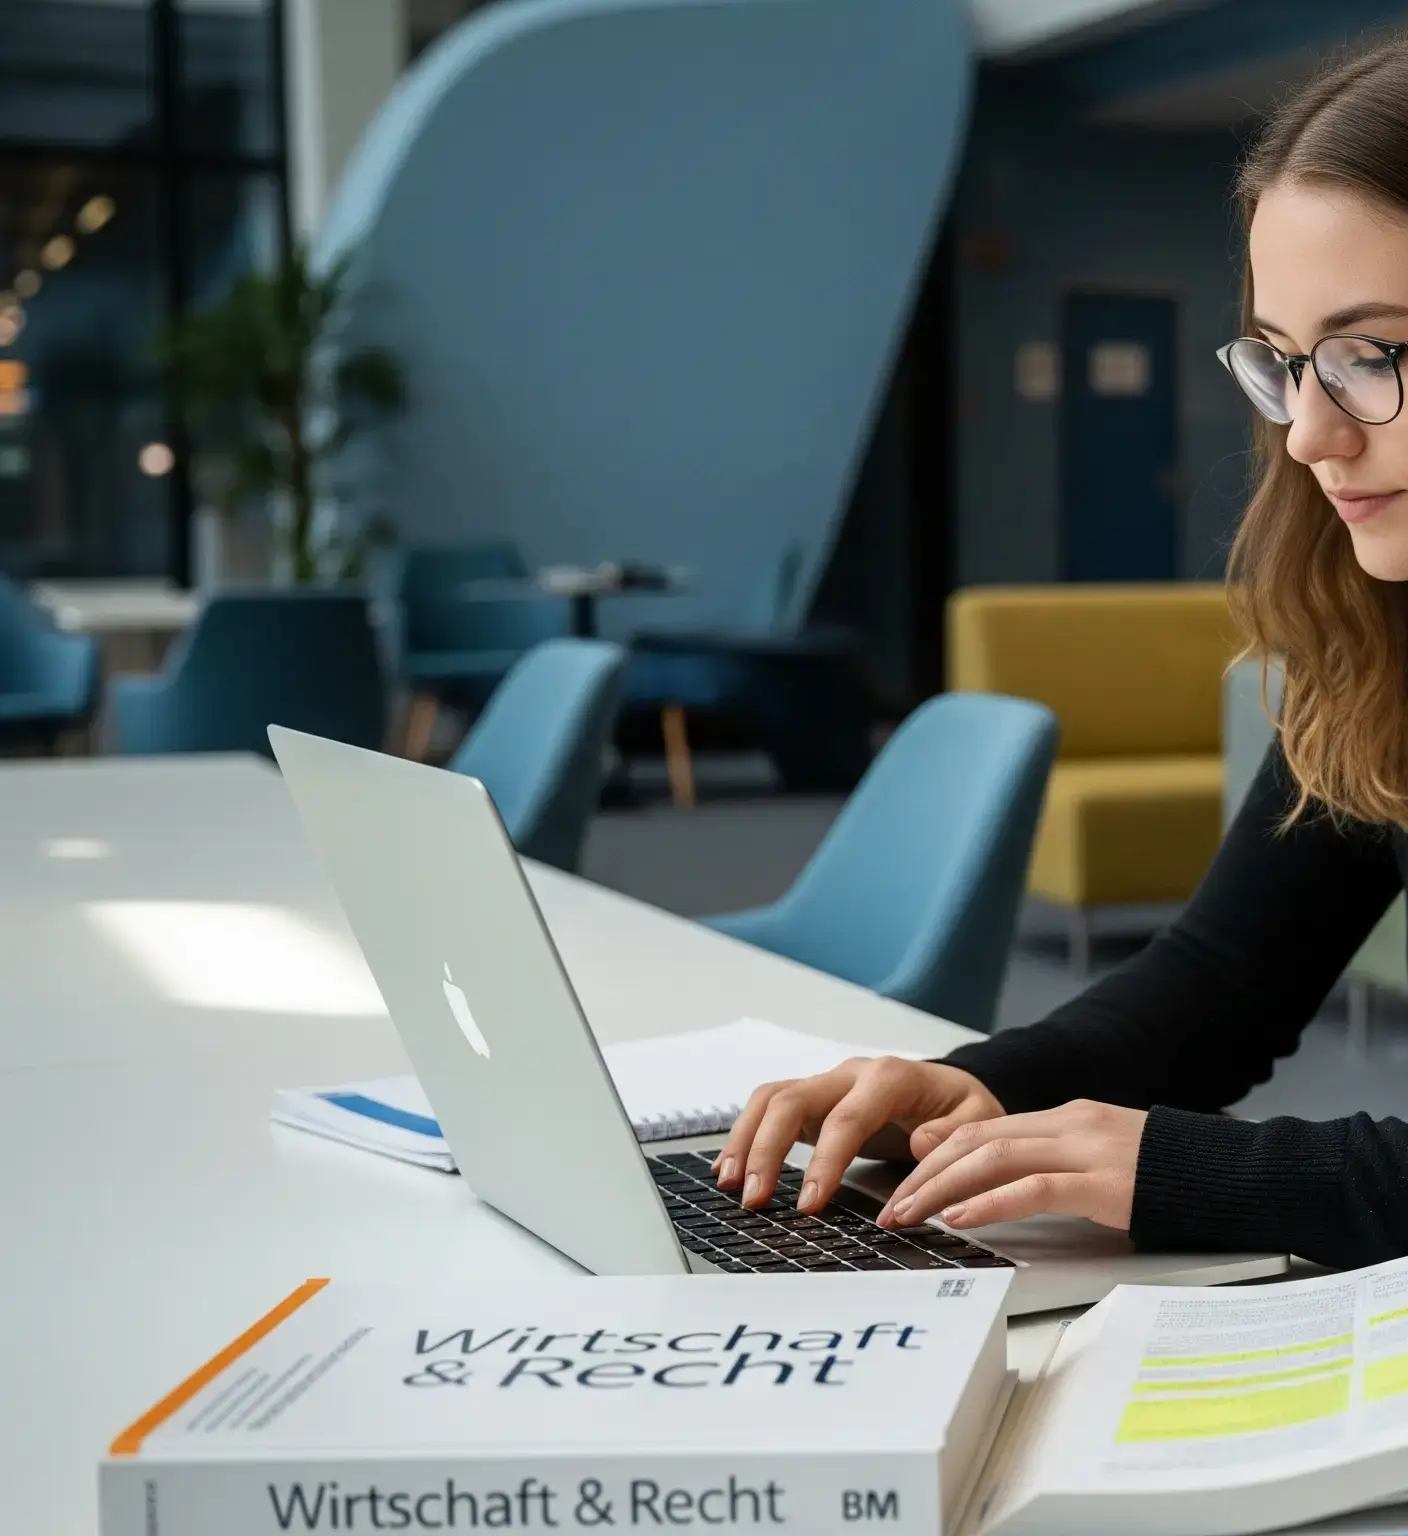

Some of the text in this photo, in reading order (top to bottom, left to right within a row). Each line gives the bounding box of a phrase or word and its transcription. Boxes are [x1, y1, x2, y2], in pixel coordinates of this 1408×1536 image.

[415, 1323, 926, 1353] Wirtschaft
[403, 1352, 854, 1388] & Recht
[267, 1475, 785, 1530] Wirtschaft & Recht
[842, 1490, 899, 1521] BM
